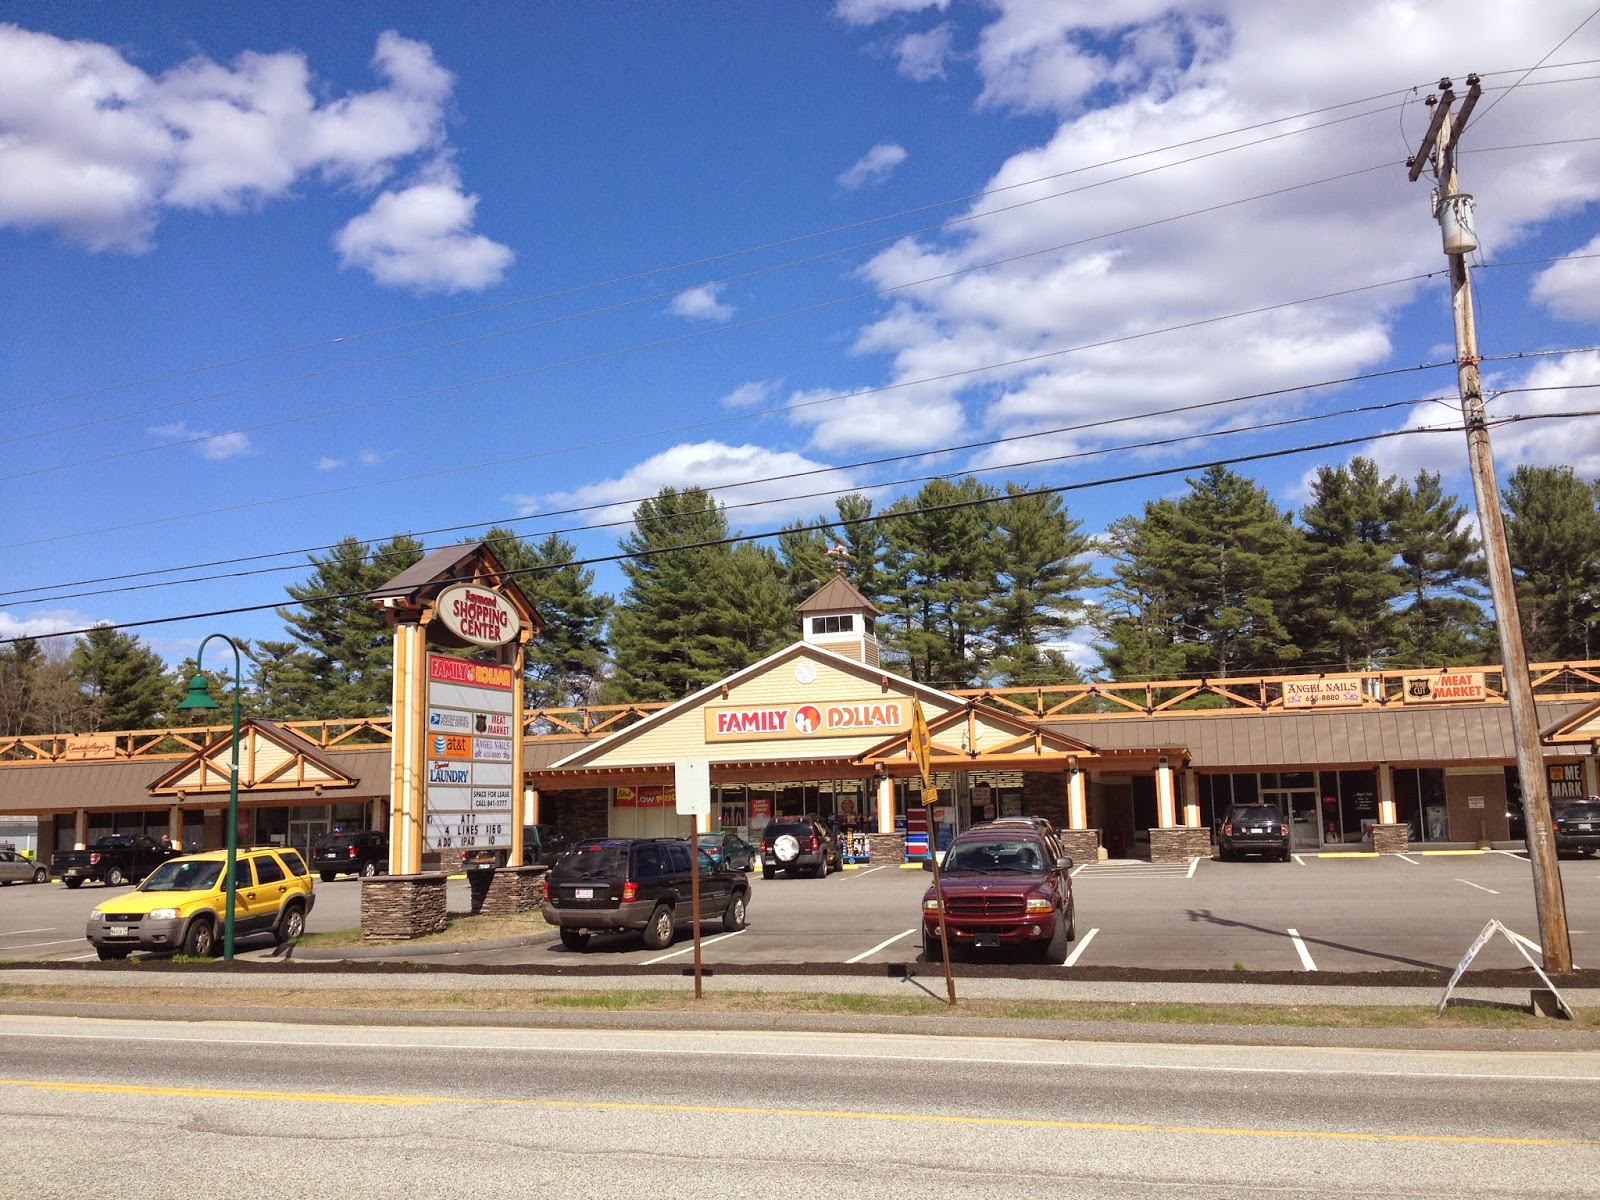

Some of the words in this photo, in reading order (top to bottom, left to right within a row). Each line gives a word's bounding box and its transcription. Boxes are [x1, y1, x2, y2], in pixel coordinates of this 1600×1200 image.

[465, 590, 497, 608] Raymond
[453, 600, 507, 627] SHOPPING
[460, 618, 501, 641] CENTER
[431, 658, 467, 681] FAMILY
[476, 665, 511, 687] DOLLAR
[1441, 675, 1472, 686] MEAT
[1288, 683, 1323, 693] ANGEL
[1326, 682, 1357, 692] NAILS
[1413, 687, 1426, 695] CUT
[1434, 686, 1482, 697] MARKET
[491, 714, 506, 724] MEAT
[718, 710, 788, 733] FAMILY
[828, 703, 900, 728] DOLLAR
[488, 725, 510, 735] MARKET
[447, 737, 466, 752] at&t
[475, 738, 493, 749] ANGEL
[494, 740, 510, 750] NAILS
[430, 770, 469, 783] LAUNDRY
[1564, 765, 1580, 780] ME
[1551, 782, 1582, 797] MARK
[461, 814, 476, 824] ATT
[445, 826, 450, 835] 4
[457, 825, 479, 835] LINES
[437, 837, 452, 847] ADD
[461, 836, 475, 847] IPAD
